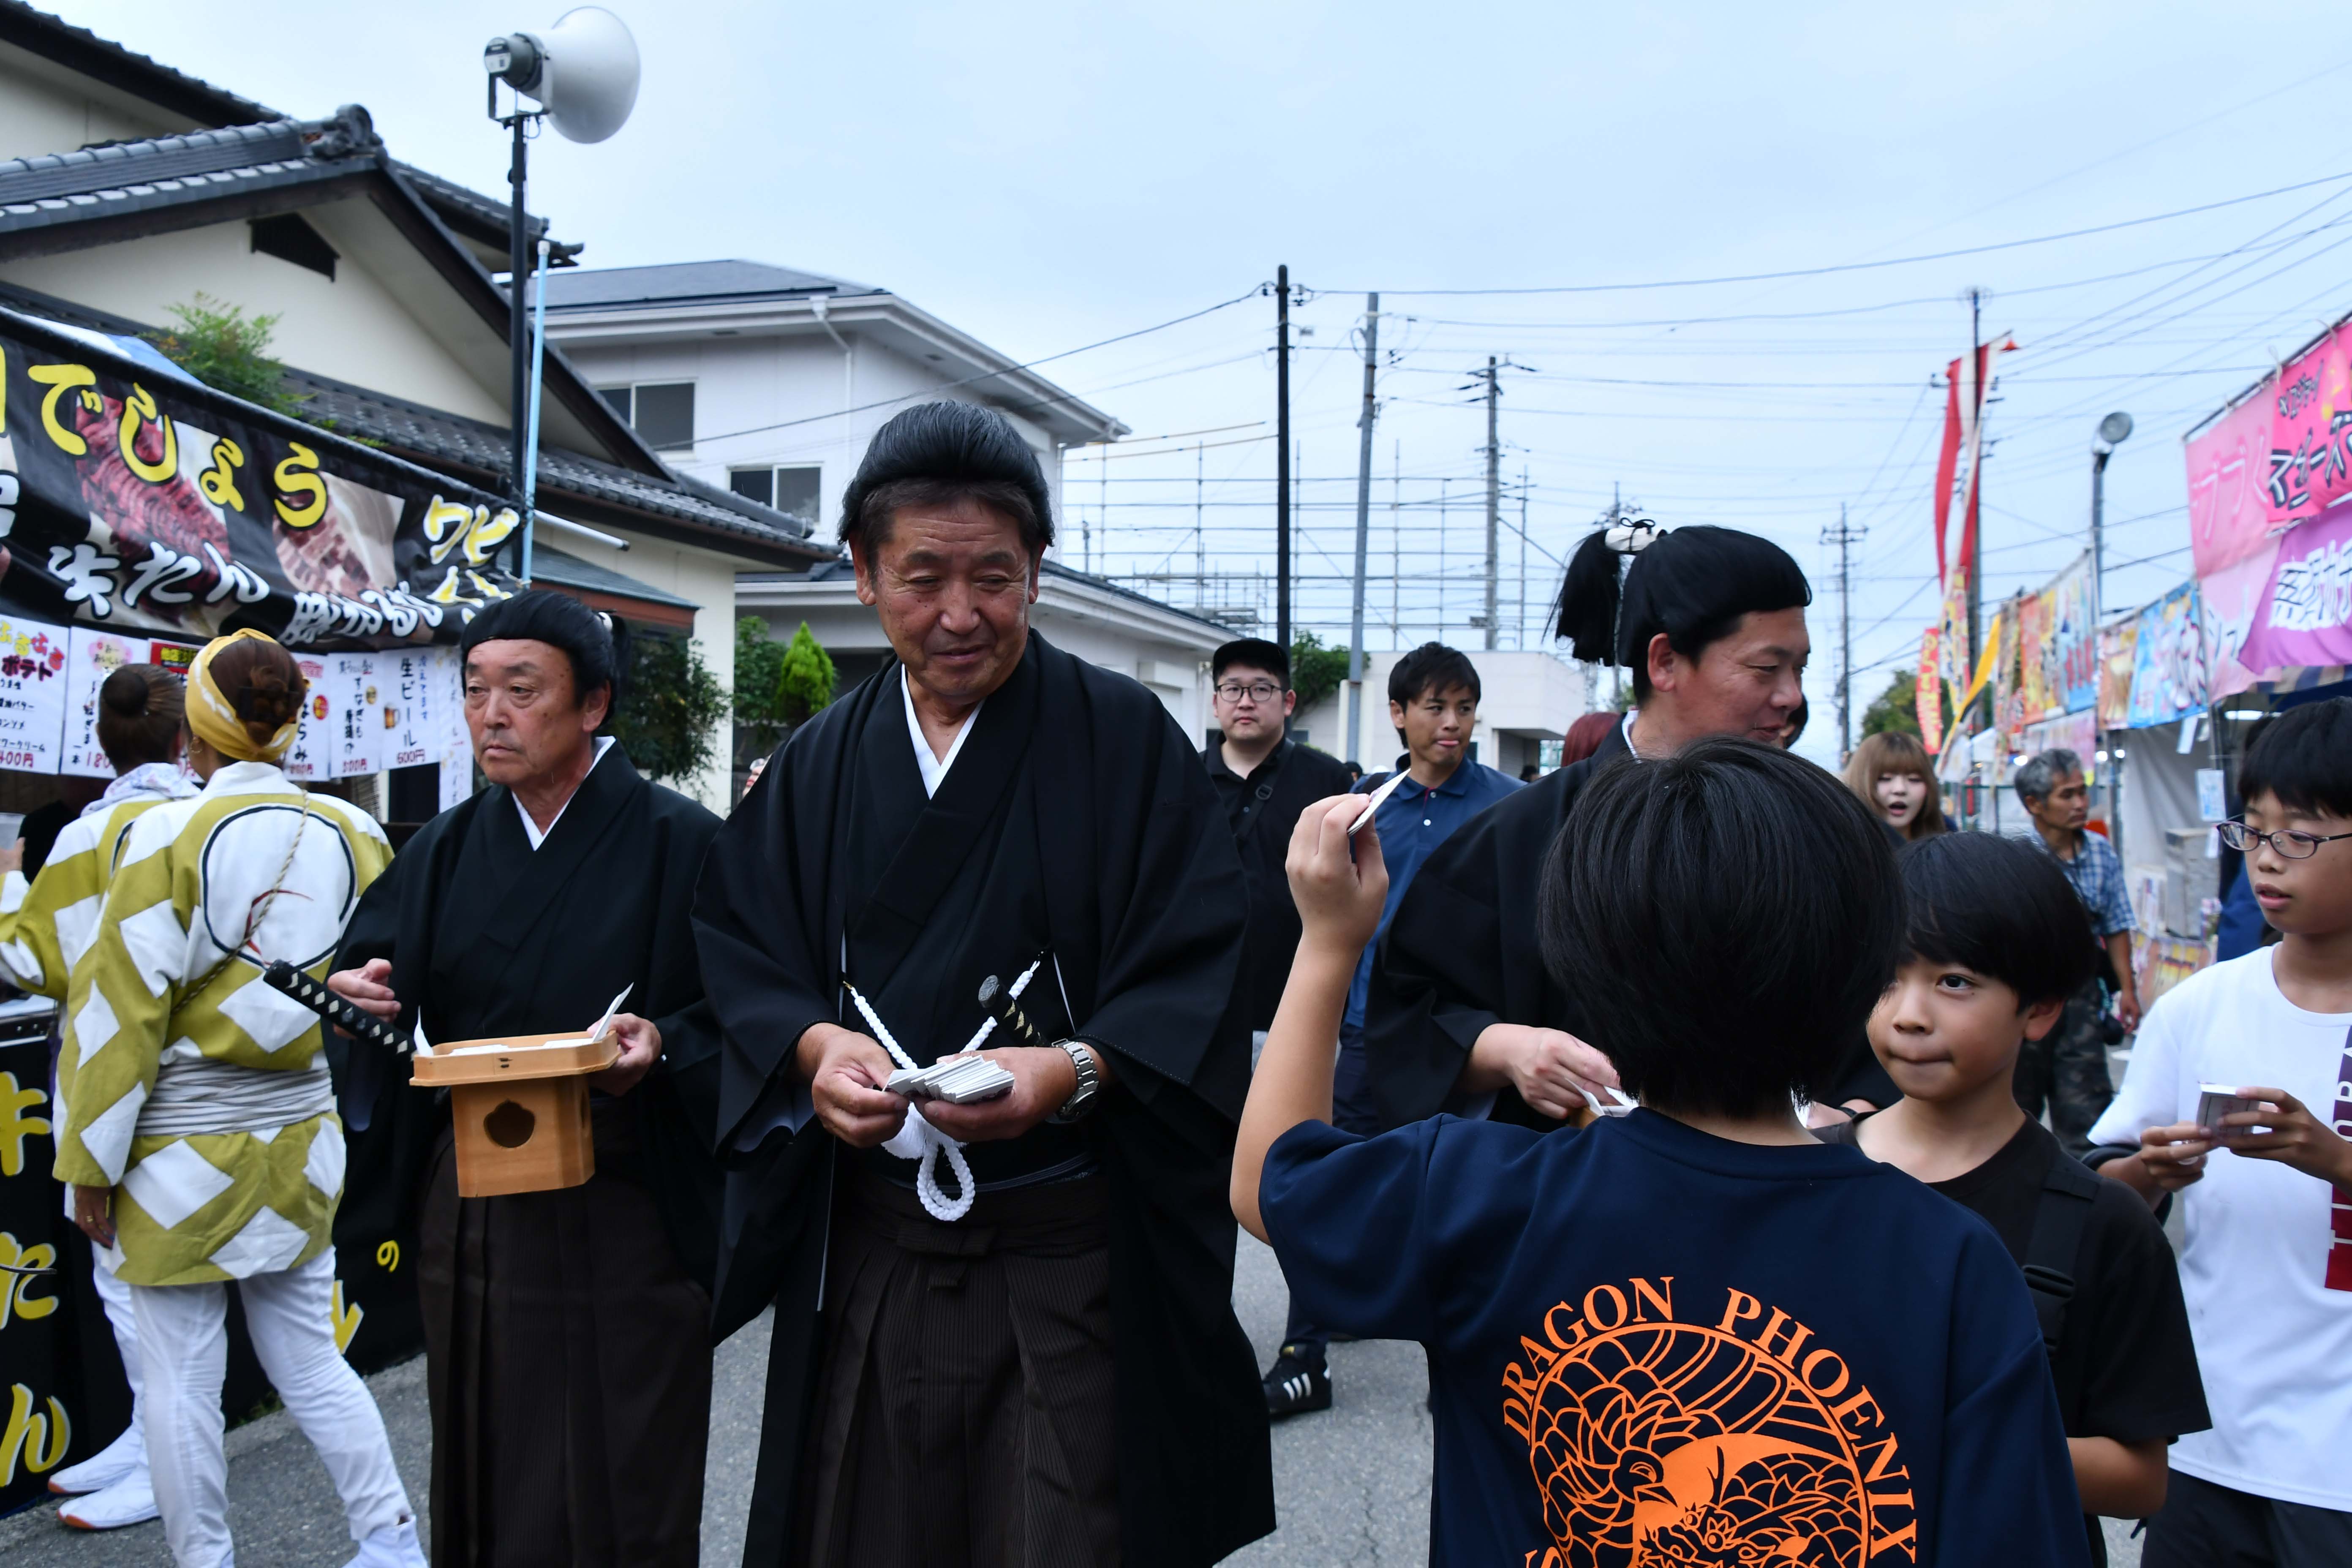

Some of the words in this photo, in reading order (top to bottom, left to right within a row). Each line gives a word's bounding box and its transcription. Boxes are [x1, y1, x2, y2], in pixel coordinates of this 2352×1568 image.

[0, 344, 328, 527] でしょう
[48, 542, 270, 617] 牛たん
[2, 655, 53, 682] ポテト
[401, 657, 417, 746] 生ビール
[0, 738, 45, 753] ワークリーム
[1502, 1276, 1674, 1446] DRAGON
[1715, 1287, 1916, 1563] PHOENIX
